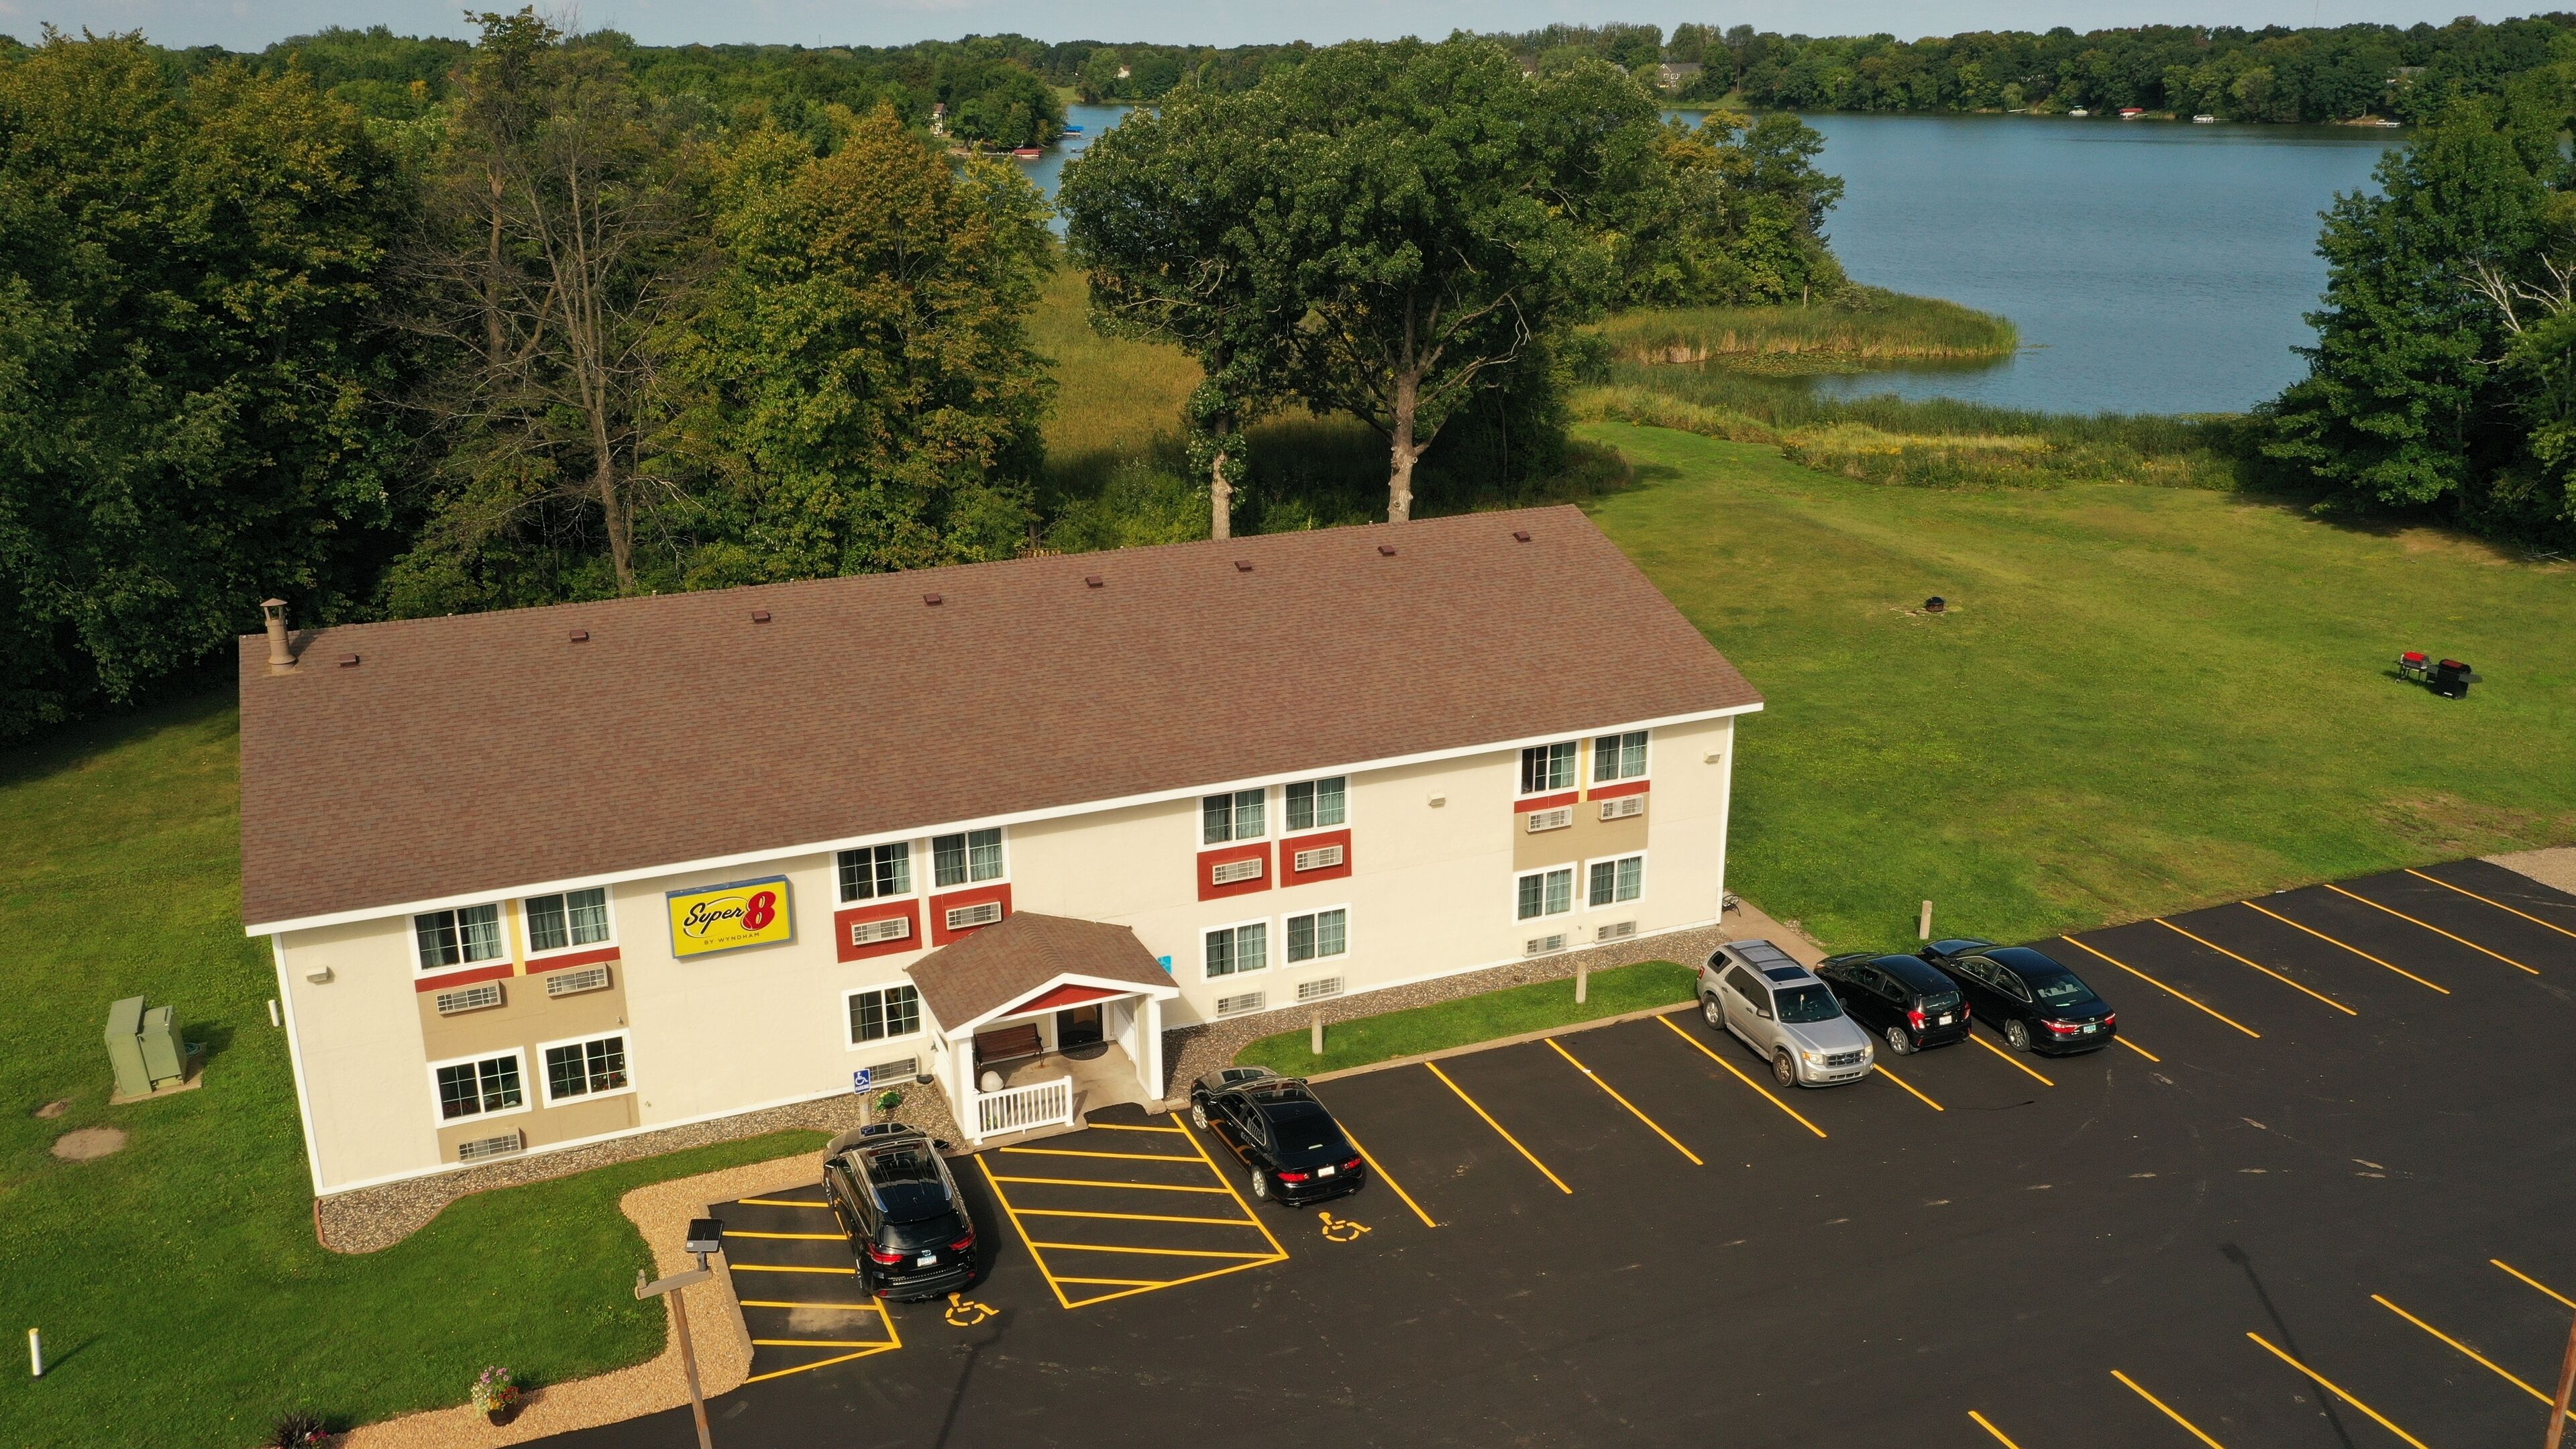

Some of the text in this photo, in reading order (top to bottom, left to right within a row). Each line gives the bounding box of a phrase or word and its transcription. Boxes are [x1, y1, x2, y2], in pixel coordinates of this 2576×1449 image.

[683, 891, 776, 934] Super 8
[718, 933, 759, 943] WYNDHAM
